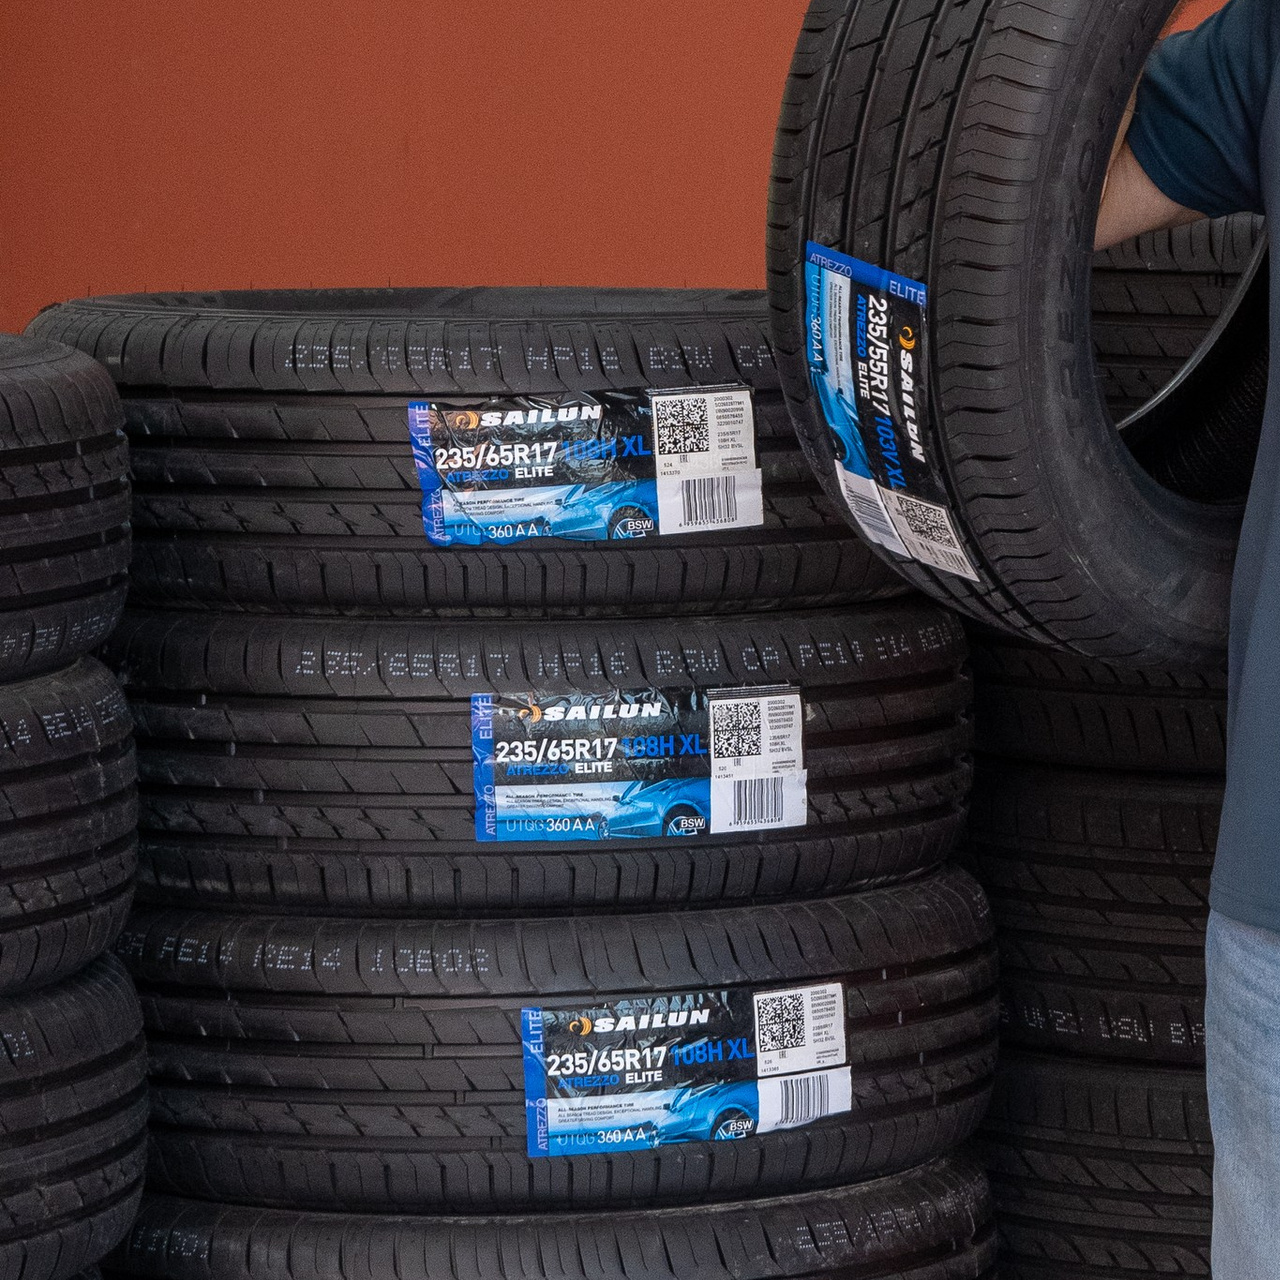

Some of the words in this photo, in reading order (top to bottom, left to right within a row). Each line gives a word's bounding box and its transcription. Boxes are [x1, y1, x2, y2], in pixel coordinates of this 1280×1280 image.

[809, 253, 852, 277] ATREZZO
[889, 280, 925, 305] ELITE
[857, 294, 867, 357] ATREZZO
[859, 361, 870, 398] ELITE
[868, 295, 890, 416] 235/55R17
[886, 467, 906, 488] XL
[479, 405, 600, 427] SAILUN
[901, 350, 925, 463] SAILUN
[419, 405, 429, 446] ELITE
[435, 441, 557, 470] 235/65R17
[622, 435, 652, 456] XL
[515, 466, 553, 479] ELITE
[628, 519, 652, 530] BSW
[480, 696, 492, 740] ELITE
[544, 703, 661, 720] SAILUN
[497, 738, 617, 763] 235/65R17
[622, 736, 674, 756] 108H
[680, 734, 707, 754] XL
[507, 764, 569, 775] ATREZZO
[575, 762, 612, 774] ELITE
[486, 785, 495, 835] ATREZZO
[681, 819, 704, 828] BSW
[531, 1010, 542, 1053] ELITE
[593, 1010, 709, 1033] SAILUN
[548, 1047, 667, 1076] 235/65R17
[671, 1041, 723, 1066] 108H
[728, 1039, 755, 1059] XL
[559, 1074, 619, 1088] ATREZZO
[626, 1072, 662, 1084] ELITE
[538, 1098, 547, 1150] ATREZZO
[730, 1120, 752, 1130] BSW
